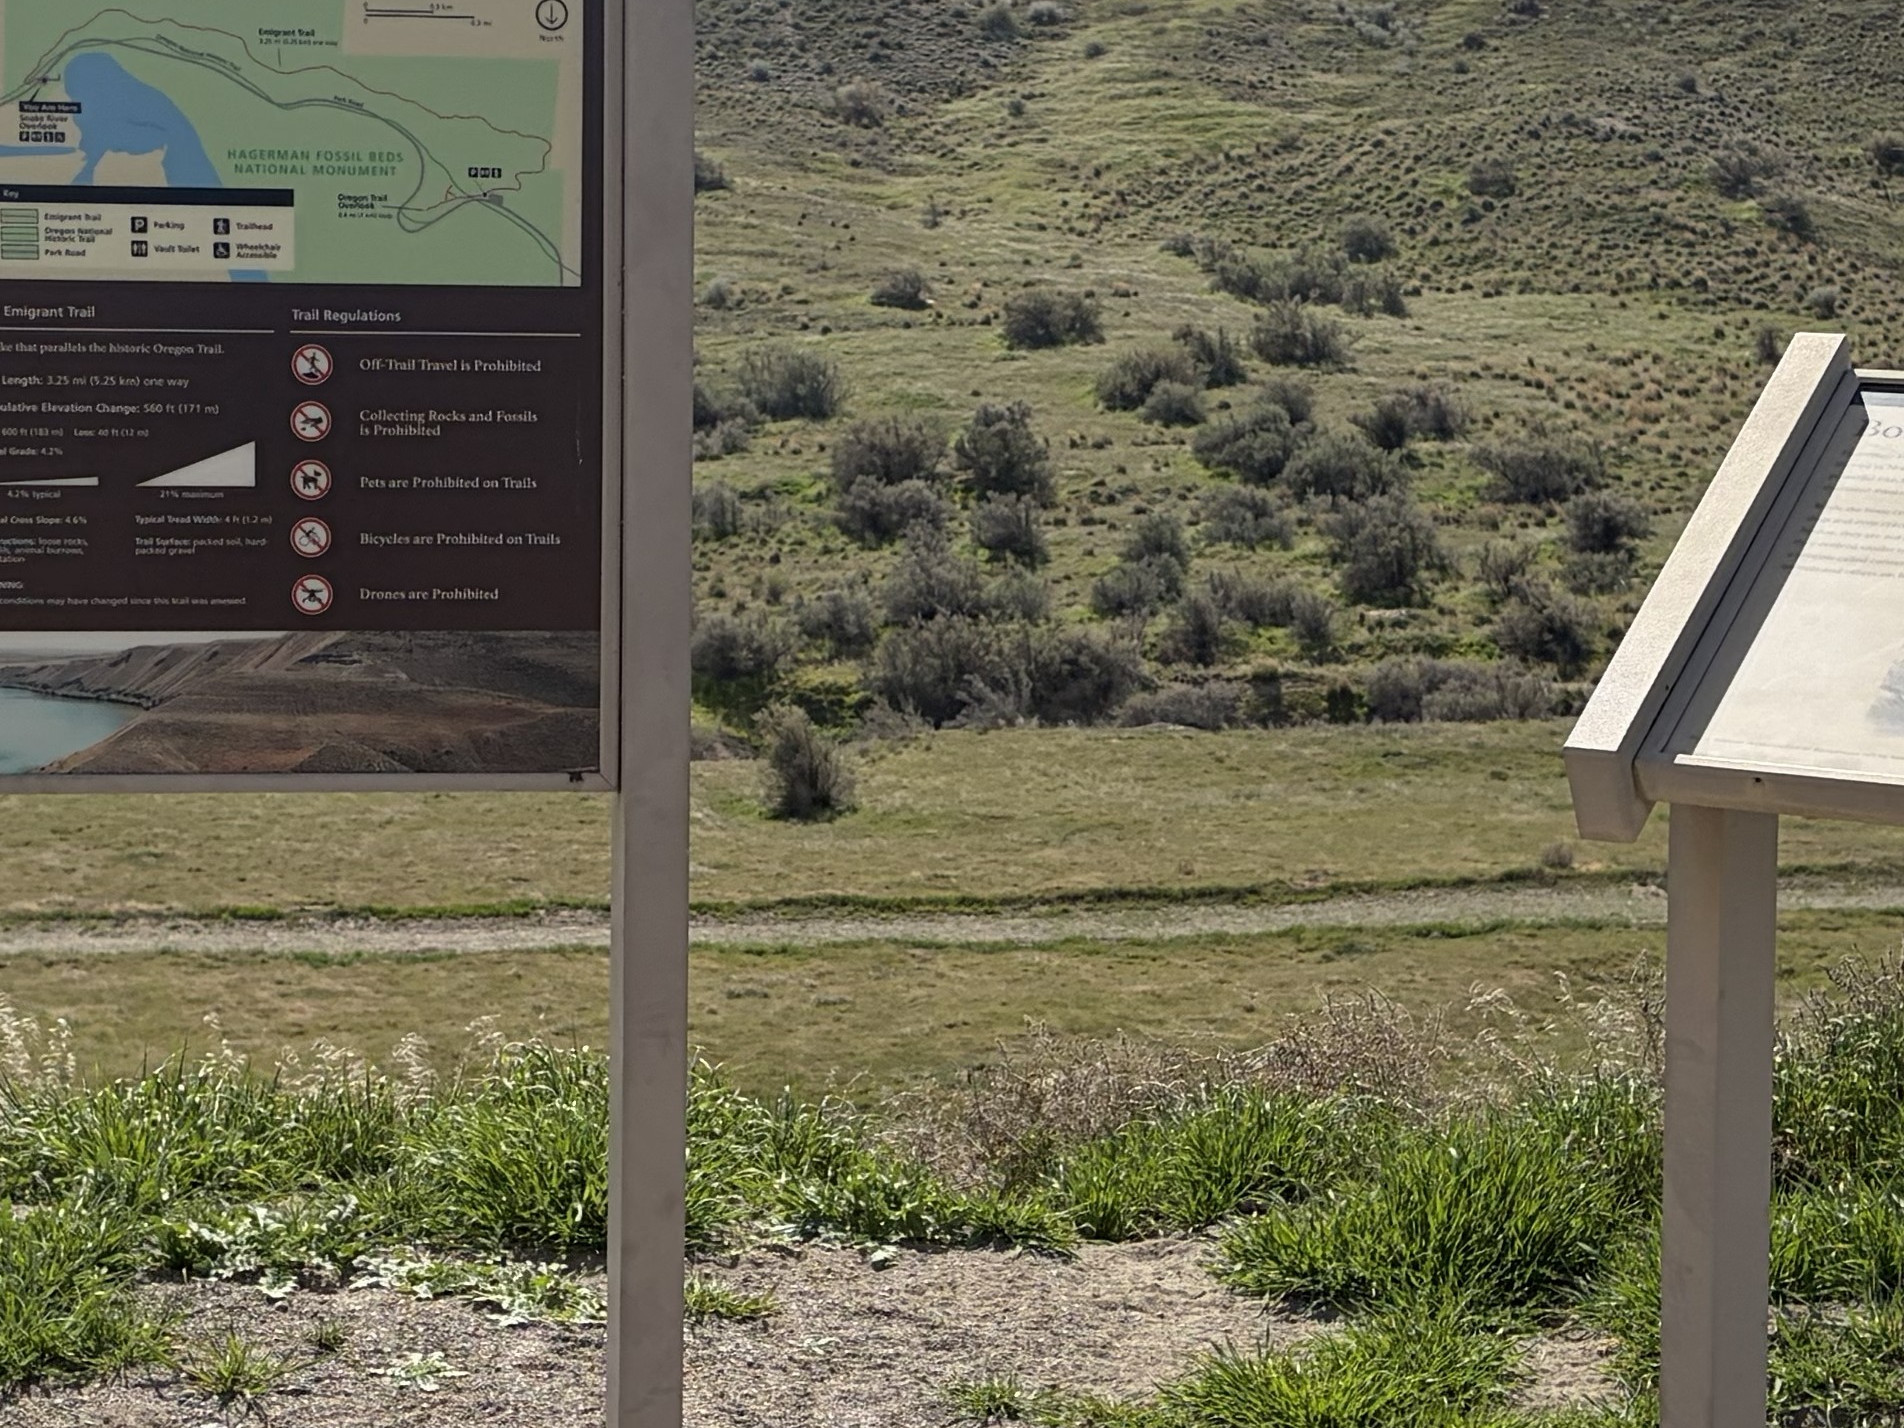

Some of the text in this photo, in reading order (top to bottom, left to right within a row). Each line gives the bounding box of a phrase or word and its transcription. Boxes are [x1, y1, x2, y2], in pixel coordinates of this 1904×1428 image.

[227, 149, 404, 162] HAGERMAN FOSSIL BEDS
[234, 162, 398, 176] NATIONAL MONUMENT
[4, 305, 63, 321] Emigrant
[68, 306, 96, 318] Trail
[292, 309, 402, 325] Trail Regulations
[15, 342, 37, 353] that
[40, 342, 86, 356] parallels
[88, 342, 106, 353] the
[108, 343, 150, 354] historic
[152, 343, 194, 357] Oregon
[196, 343, 226, 354] Trail.
[359, 359, 542, 372] Off-Trail Travel is Prohibited
[1, 375, 42, 389] Length:
[46, 376, 70, 386] 3.25
[72, 376, 86, 386] mi
[118, 376, 140, 390] km)
[143, 378, 164, 387] one
[166, 379, 190, 390] way
[40, 402, 92, 413] Elevation
[95, 403, 140, 416] Change:
[143, 403, 163, 414] 560
[166, 403, 174, 414] ft
[204, 404, 220, 417] m)
[359, 410, 538, 425] Collecting Rocks and Fossils
[359, 424, 441, 436] is Prohibited
[359, 476, 538, 489] Pets are Prohibited on Trails
[359, 533, 561, 547] Bicycles are Prohibited on Trails
[359, 588, 499, 600] Drones are Prohibited
